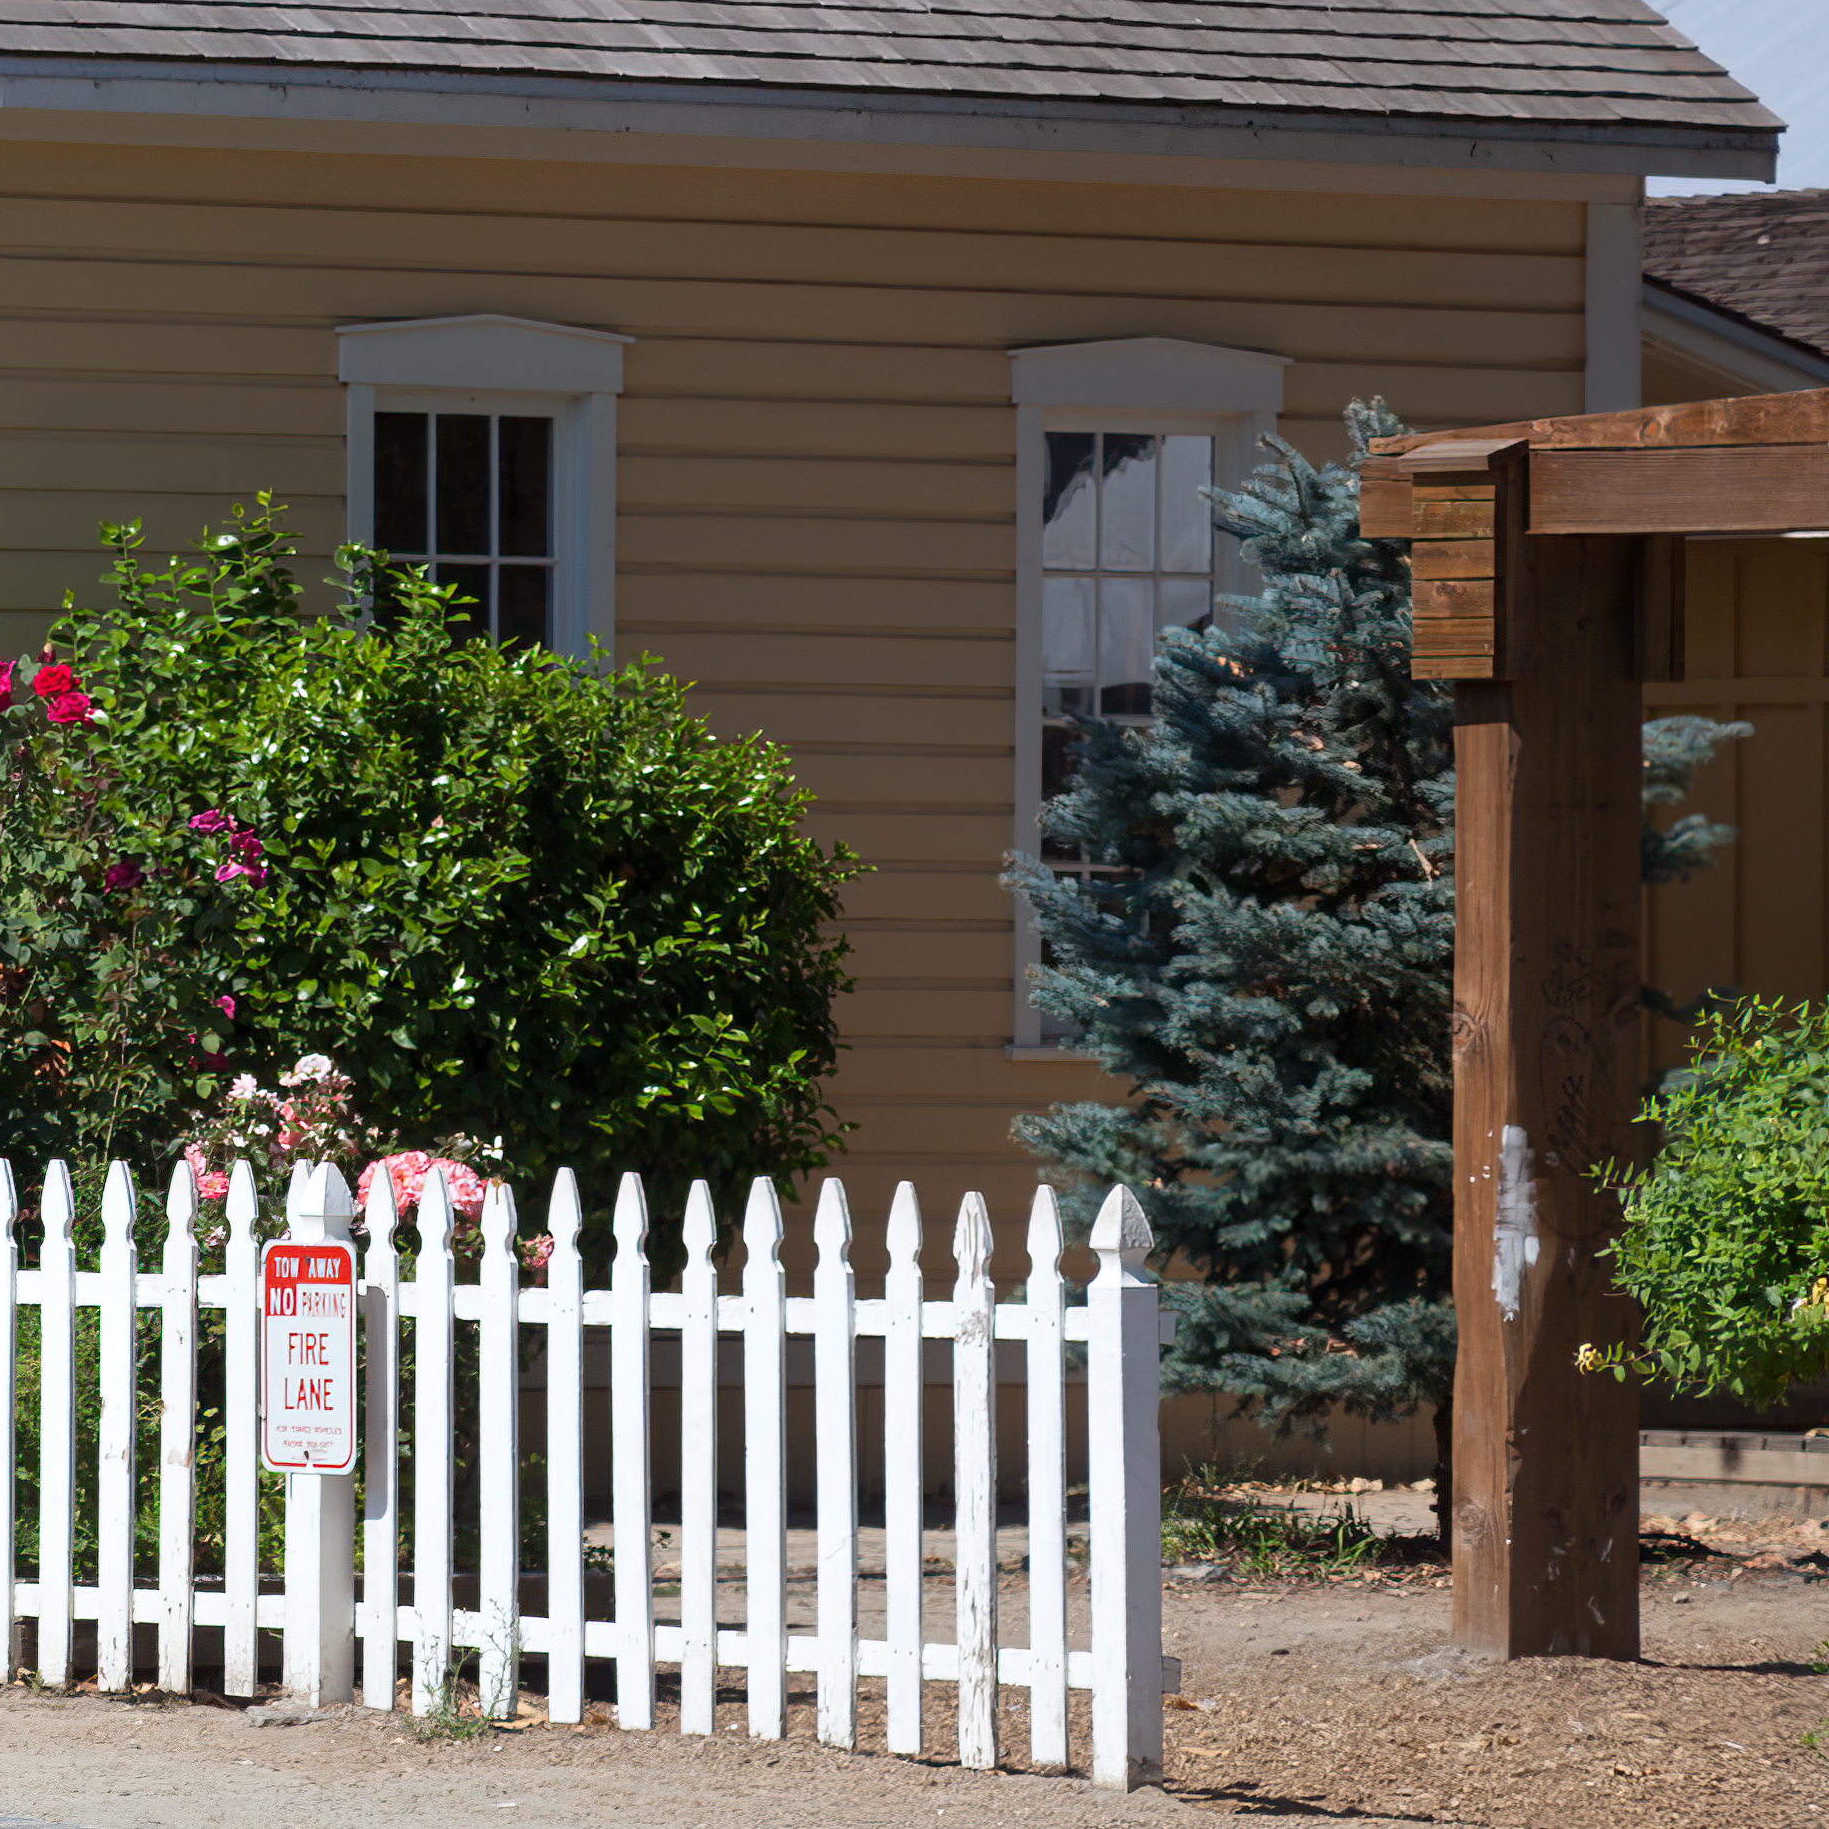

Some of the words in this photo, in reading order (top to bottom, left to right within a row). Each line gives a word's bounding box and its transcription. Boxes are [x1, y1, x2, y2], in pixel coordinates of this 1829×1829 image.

[274, 1257, 299, 1278] TOW
[308, 1258, 340, 1278] AWAY
[269, 1287, 294, 1316] NO
[288, 1333, 329, 1365] FIRE
[284, 1378, 333, 1410] LANE
